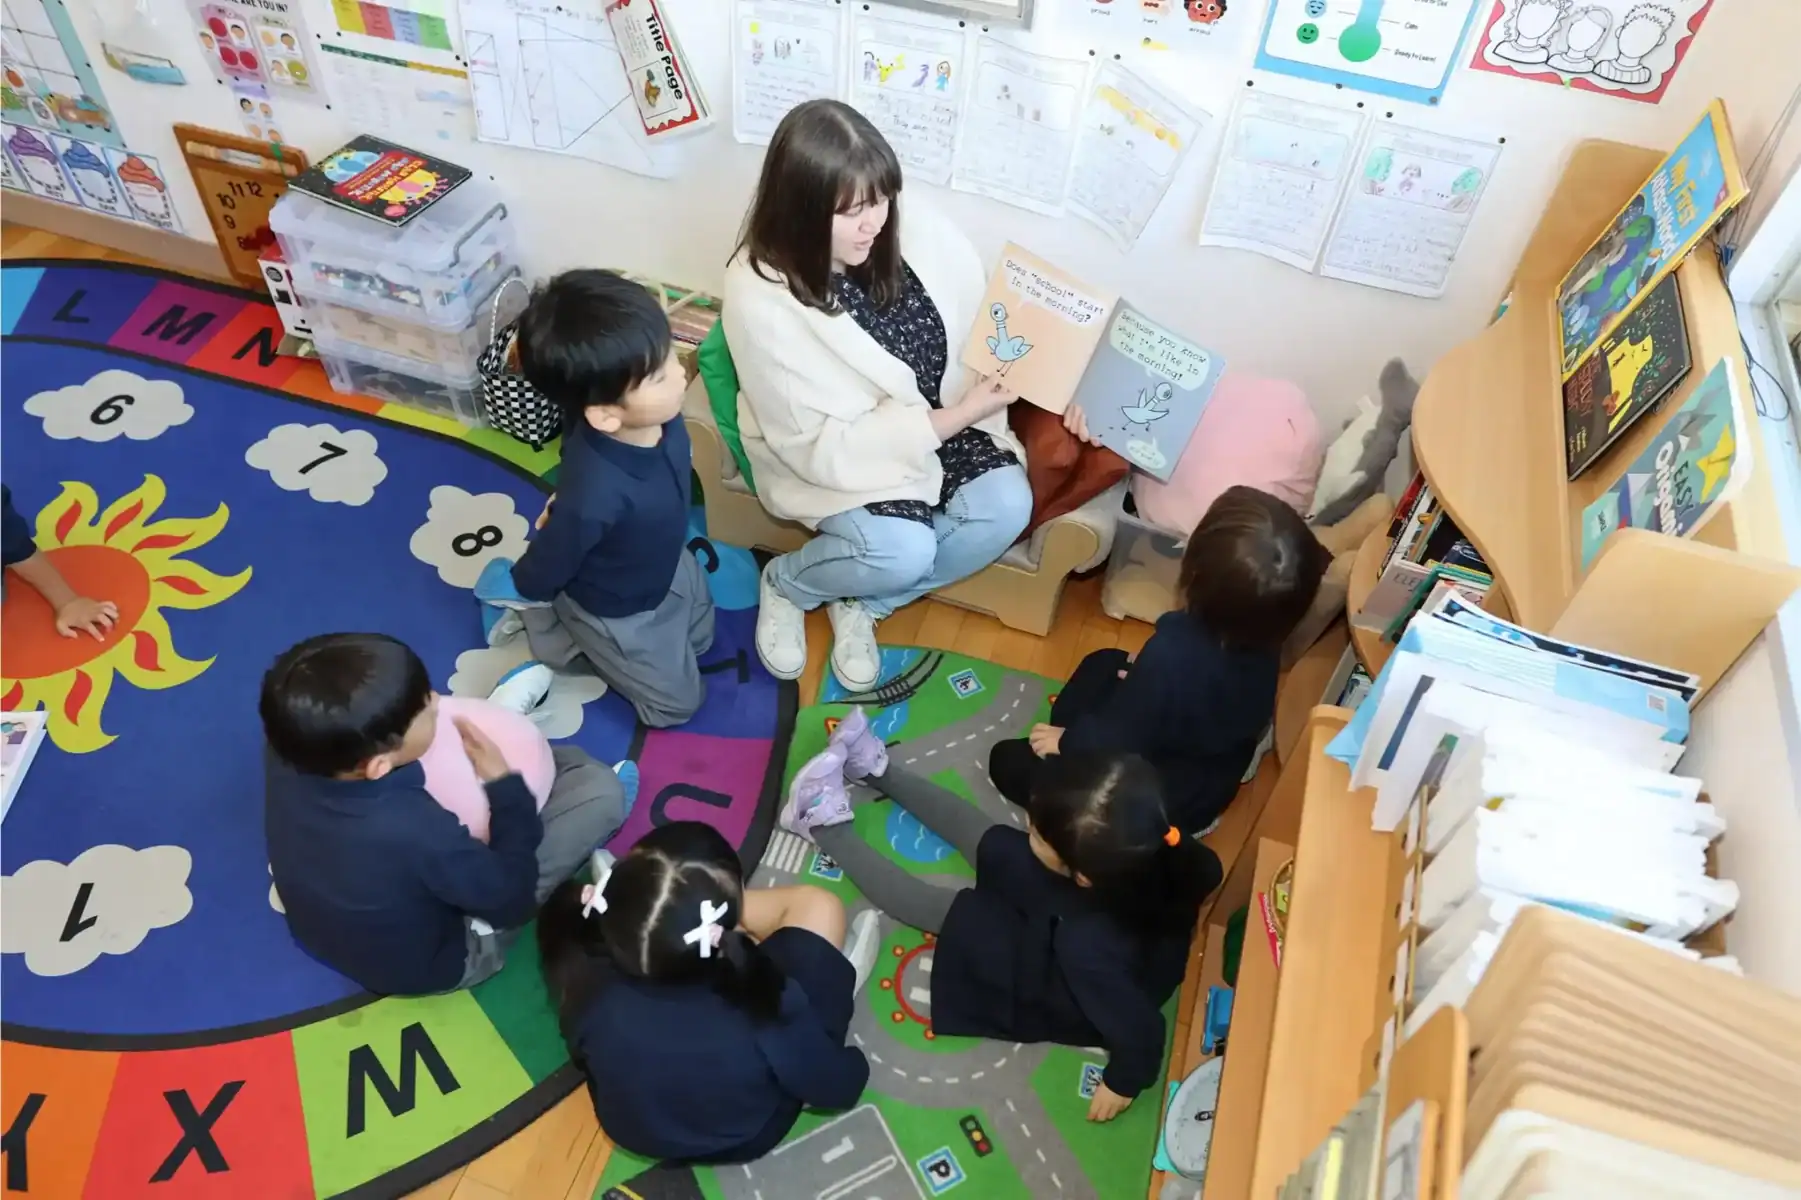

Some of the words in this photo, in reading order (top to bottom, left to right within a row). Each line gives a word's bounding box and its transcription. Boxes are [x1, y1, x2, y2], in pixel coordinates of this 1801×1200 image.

[258, 0, 274, 11] YOU
[275, 2, 288, 12] IN?
[646, 13, 664, 52] Title
[661, 55, 682, 100] Page
[1394, 48, 1410, 59] Ready
[1419, 54, 1436, 63] Learn!
[227, 181, 244, 198] 11
[245, 181, 264, 198] 12
[1668, 154, 1690, 194] My
[216, 192, 236, 210] 10
[1674, 180, 1698, 228] First
[224, 214, 236, 230] 9
[1006, 260, 1027, 276] Does
[1078, 298, 1104, 314] start
[1011, 276, 1022, 288] in
[1025, 284, 1042, 298] the
[1044, 296, 1092, 323] morning?
[52, 290, 89, 324] L
[140, 306, 217, 344] M
[232, 327, 278, 367] N
[1116, 324, 1136, 340] what
[1139, 338, 1156, 352] I'm
[1160, 348, 1182, 367] like
[1187, 363, 1199, 376] in
[1120, 340, 1134, 356] the
[1137, 353, 1184, 382] morning!
[1157, 336, 1176, 350] you
[1180, 344, 1207, 364] know
[89, 394, 134, 426] 6
[298, 441, 348, 476] 7
[1655, 440, 1686, 537] Origami
[1672, 460, 1696, 516] EASY
[451, 524, 504, 557] 8
[698, 648, 749, 684] T
[650, 782, 732, 828] U
[60, 882, 98, 942] 1
[346, 1022, 462, 1138] W
[0, 1093, 48, 1192] Y
[148, 1080, 246, 1184] X
[821, 1136, 854, 1164] 1
[928, 1158, 951, 1178] P
